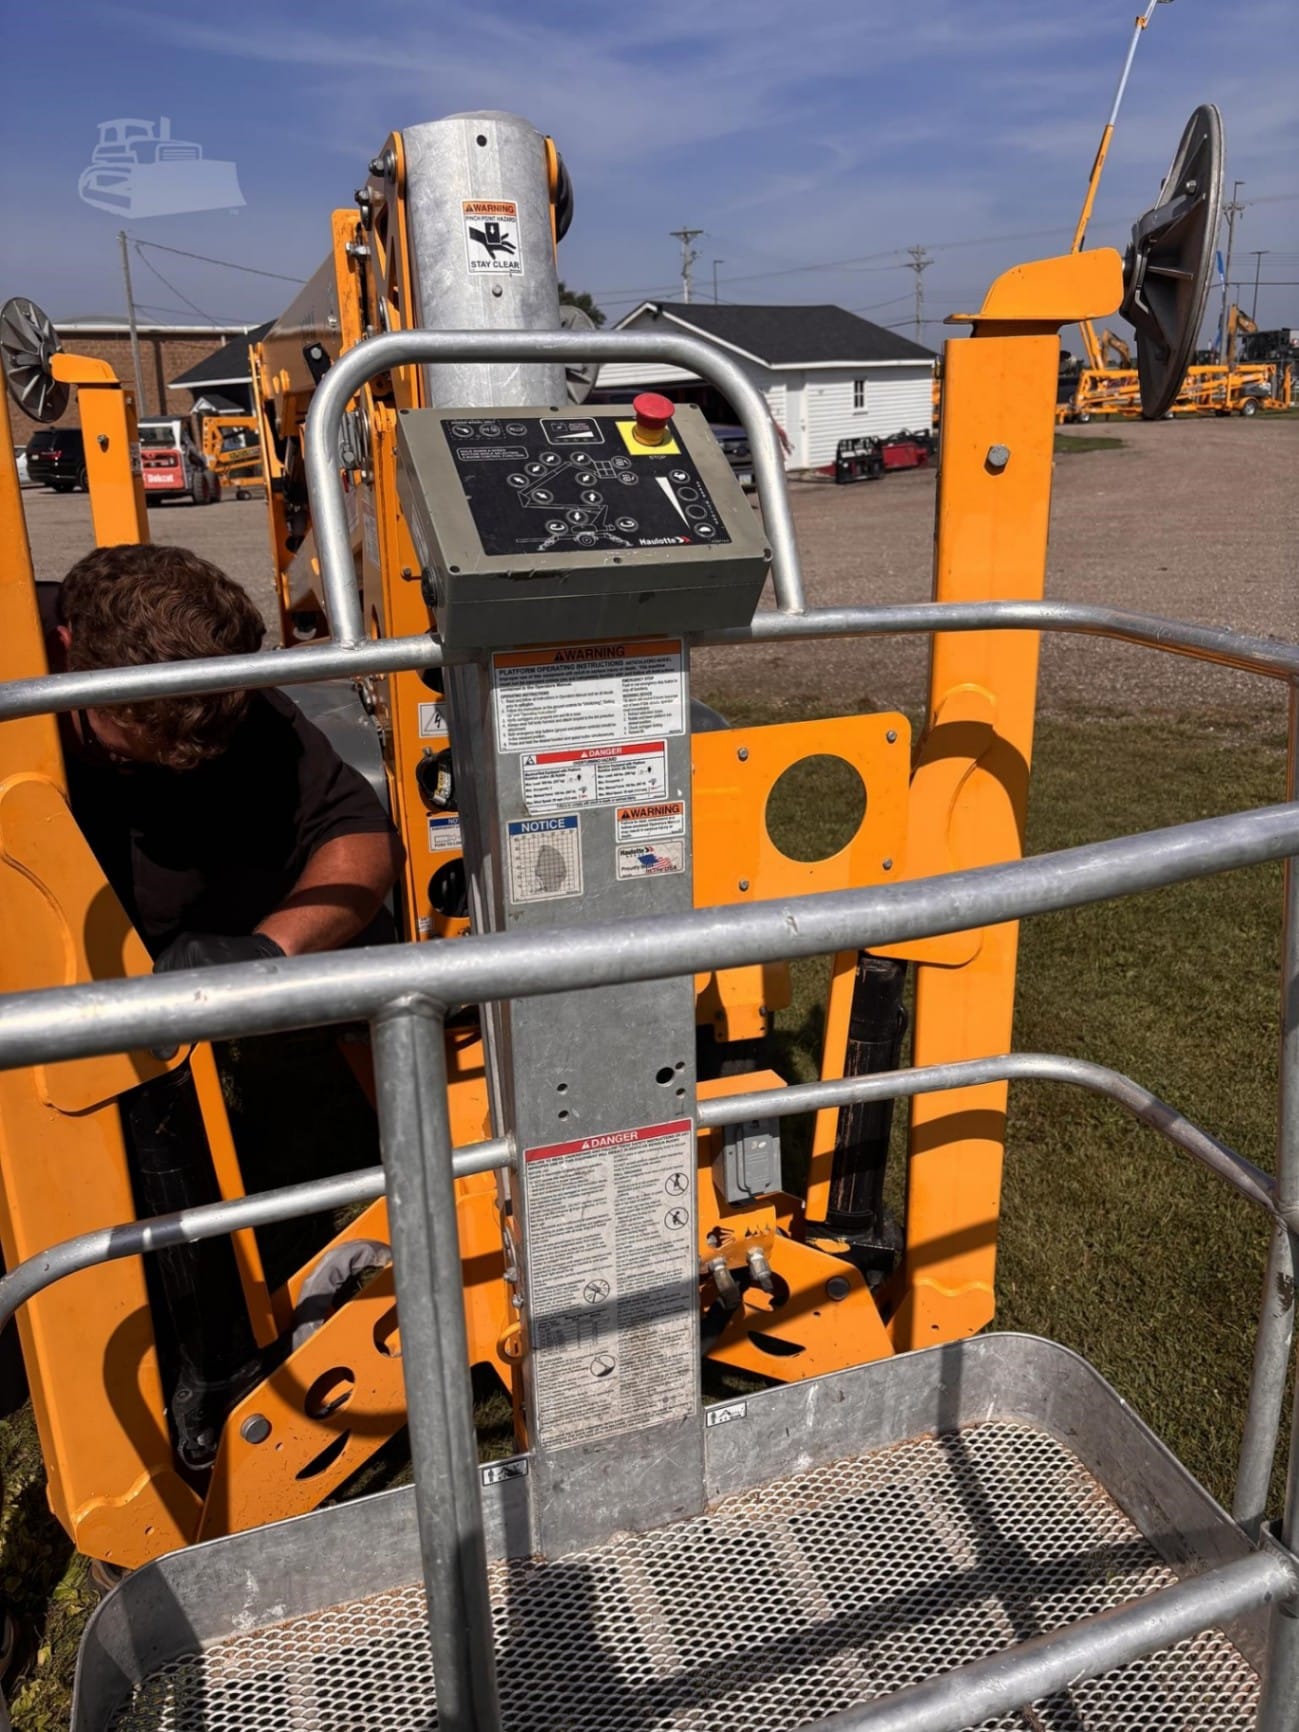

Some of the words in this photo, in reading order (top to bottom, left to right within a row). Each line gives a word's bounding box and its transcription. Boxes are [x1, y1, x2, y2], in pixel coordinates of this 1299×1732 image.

[473, 203, 514, 214] WARNING
[471, 260, 491, 269] STAY
[493, 261, 520, 269] CLEAR
[639, 536, 677, 546] Haulotte
[565, 646, 626, 661] WARNING
[499, 667, 536, 676] PLATFORM
[537, 664, 576, 673] OPERATING
[577, 660, 624, 670] INSTRUCTIONS
[589, 748, 622, 757] DANGER
[631, 804, 680, 817] WARNING
[521, 818, 566, 832] NOTICE
[592, 1131, 639, 1148] DANGER
